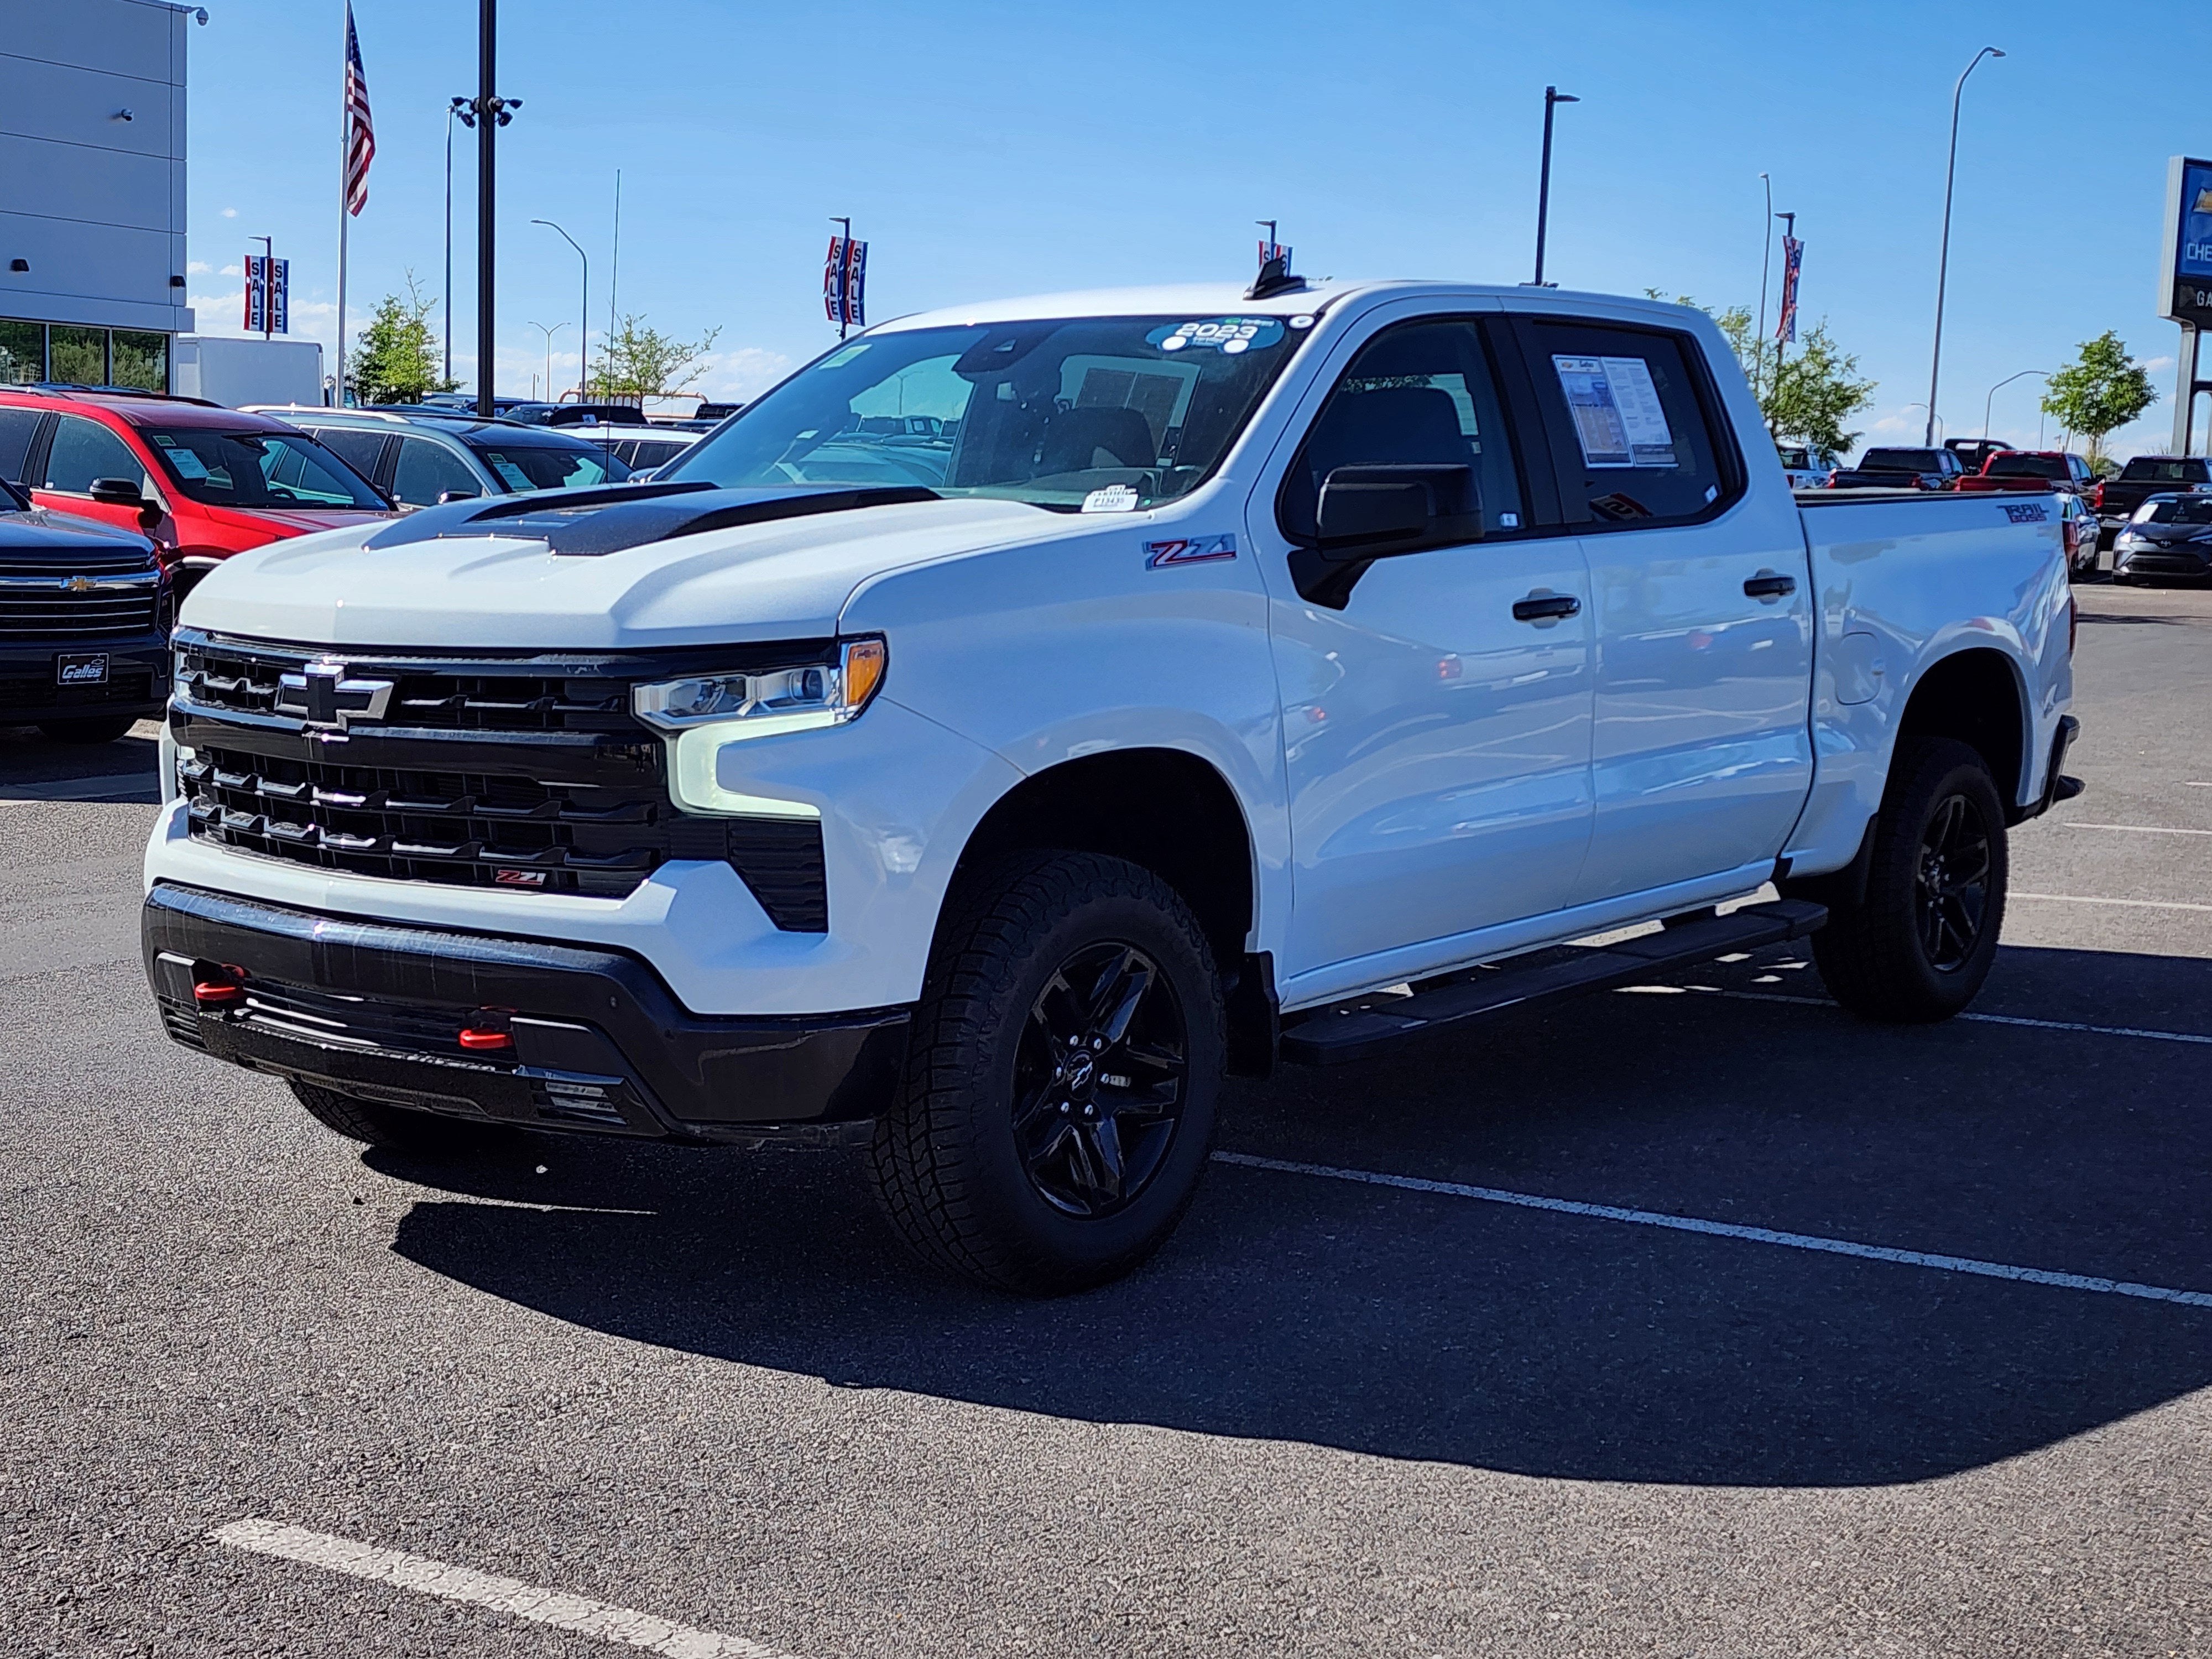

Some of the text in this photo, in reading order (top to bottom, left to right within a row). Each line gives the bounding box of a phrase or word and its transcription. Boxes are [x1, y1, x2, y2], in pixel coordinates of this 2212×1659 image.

[251, 262, 259, 325] SALE
[830, 244, 841, 316] SALE
[851, 248, 862, 319] SALE
[274, 265, 283, 327] SALE
[1175, 322, 1258, 339] 2023
[1996, 503, 2049, 517] TRAIL
[2010, 514, 2048, 524] BOSS
[1142, 533, 1237, 571] Z71
[62, 664, 103, 679] Galles
[495, 869, 546, 885] Z71
